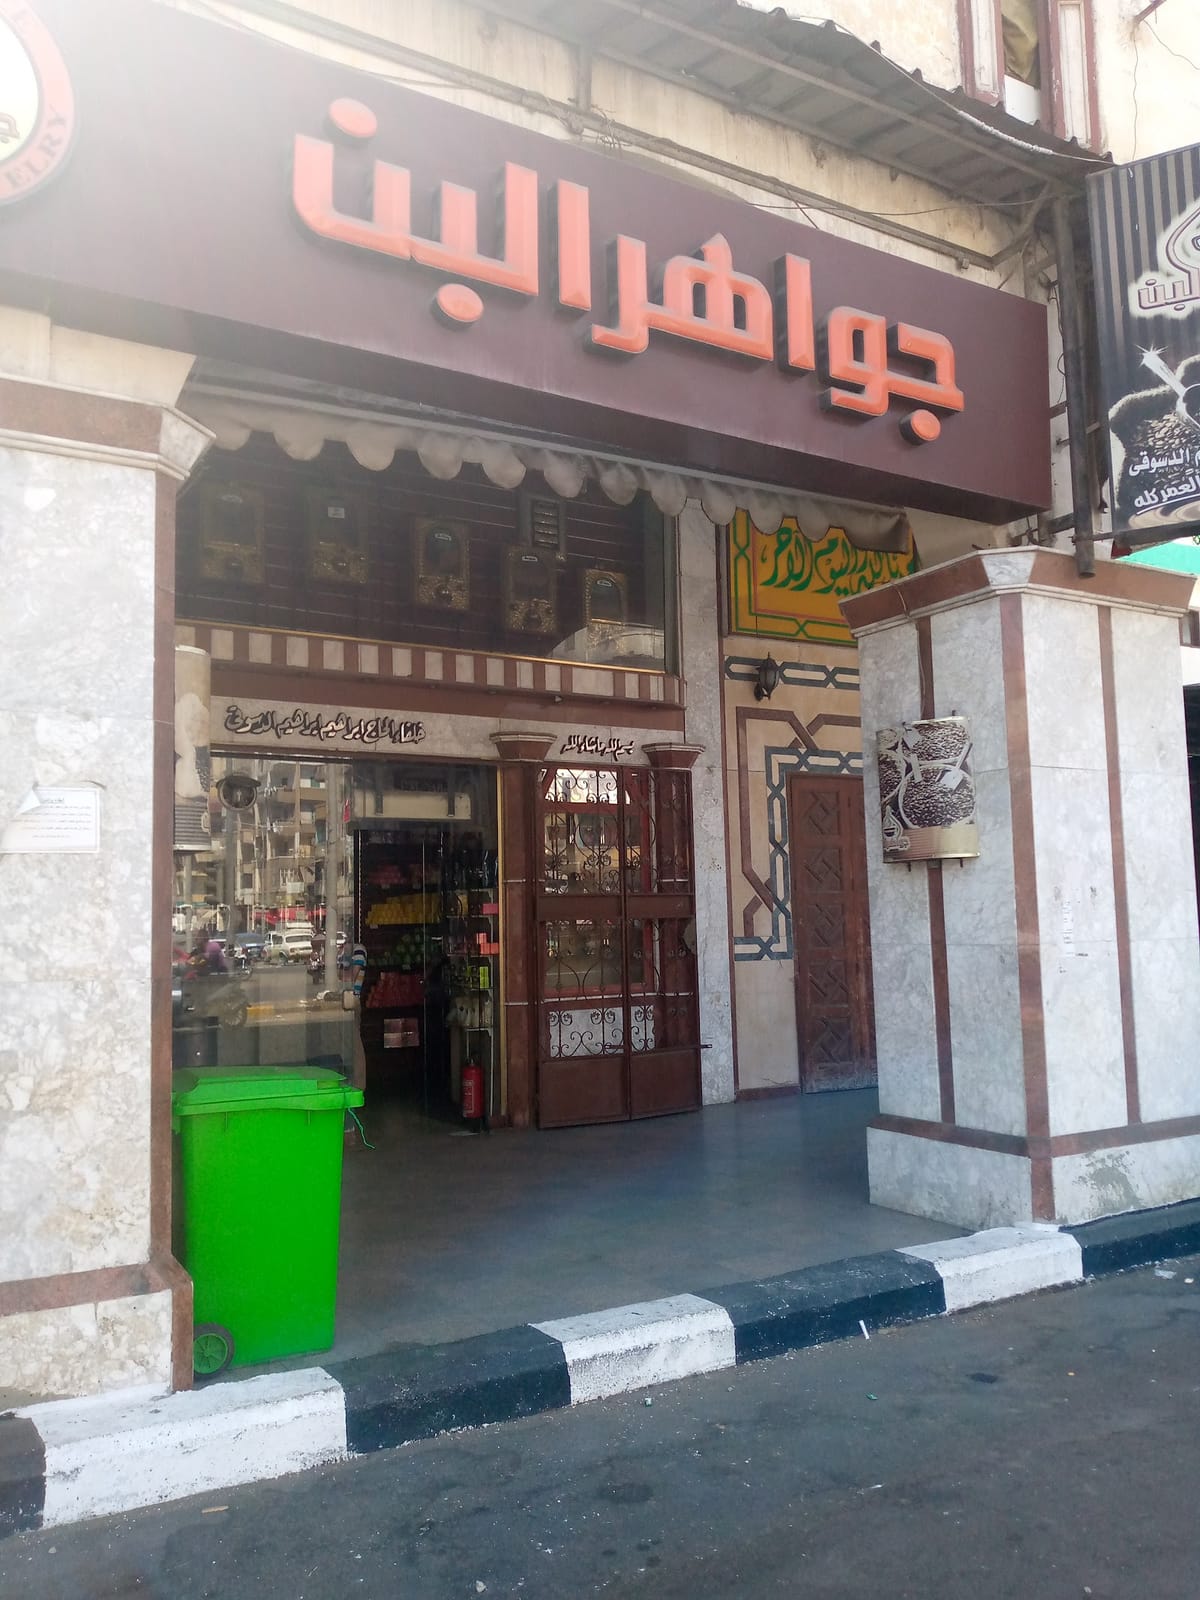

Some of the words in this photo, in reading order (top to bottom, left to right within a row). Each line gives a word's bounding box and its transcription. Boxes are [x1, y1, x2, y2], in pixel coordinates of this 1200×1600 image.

[293, 98, 591, 322] البن
[592, 233, 964, 441] جواهر
[1134, 487, 1159, 507] كله
